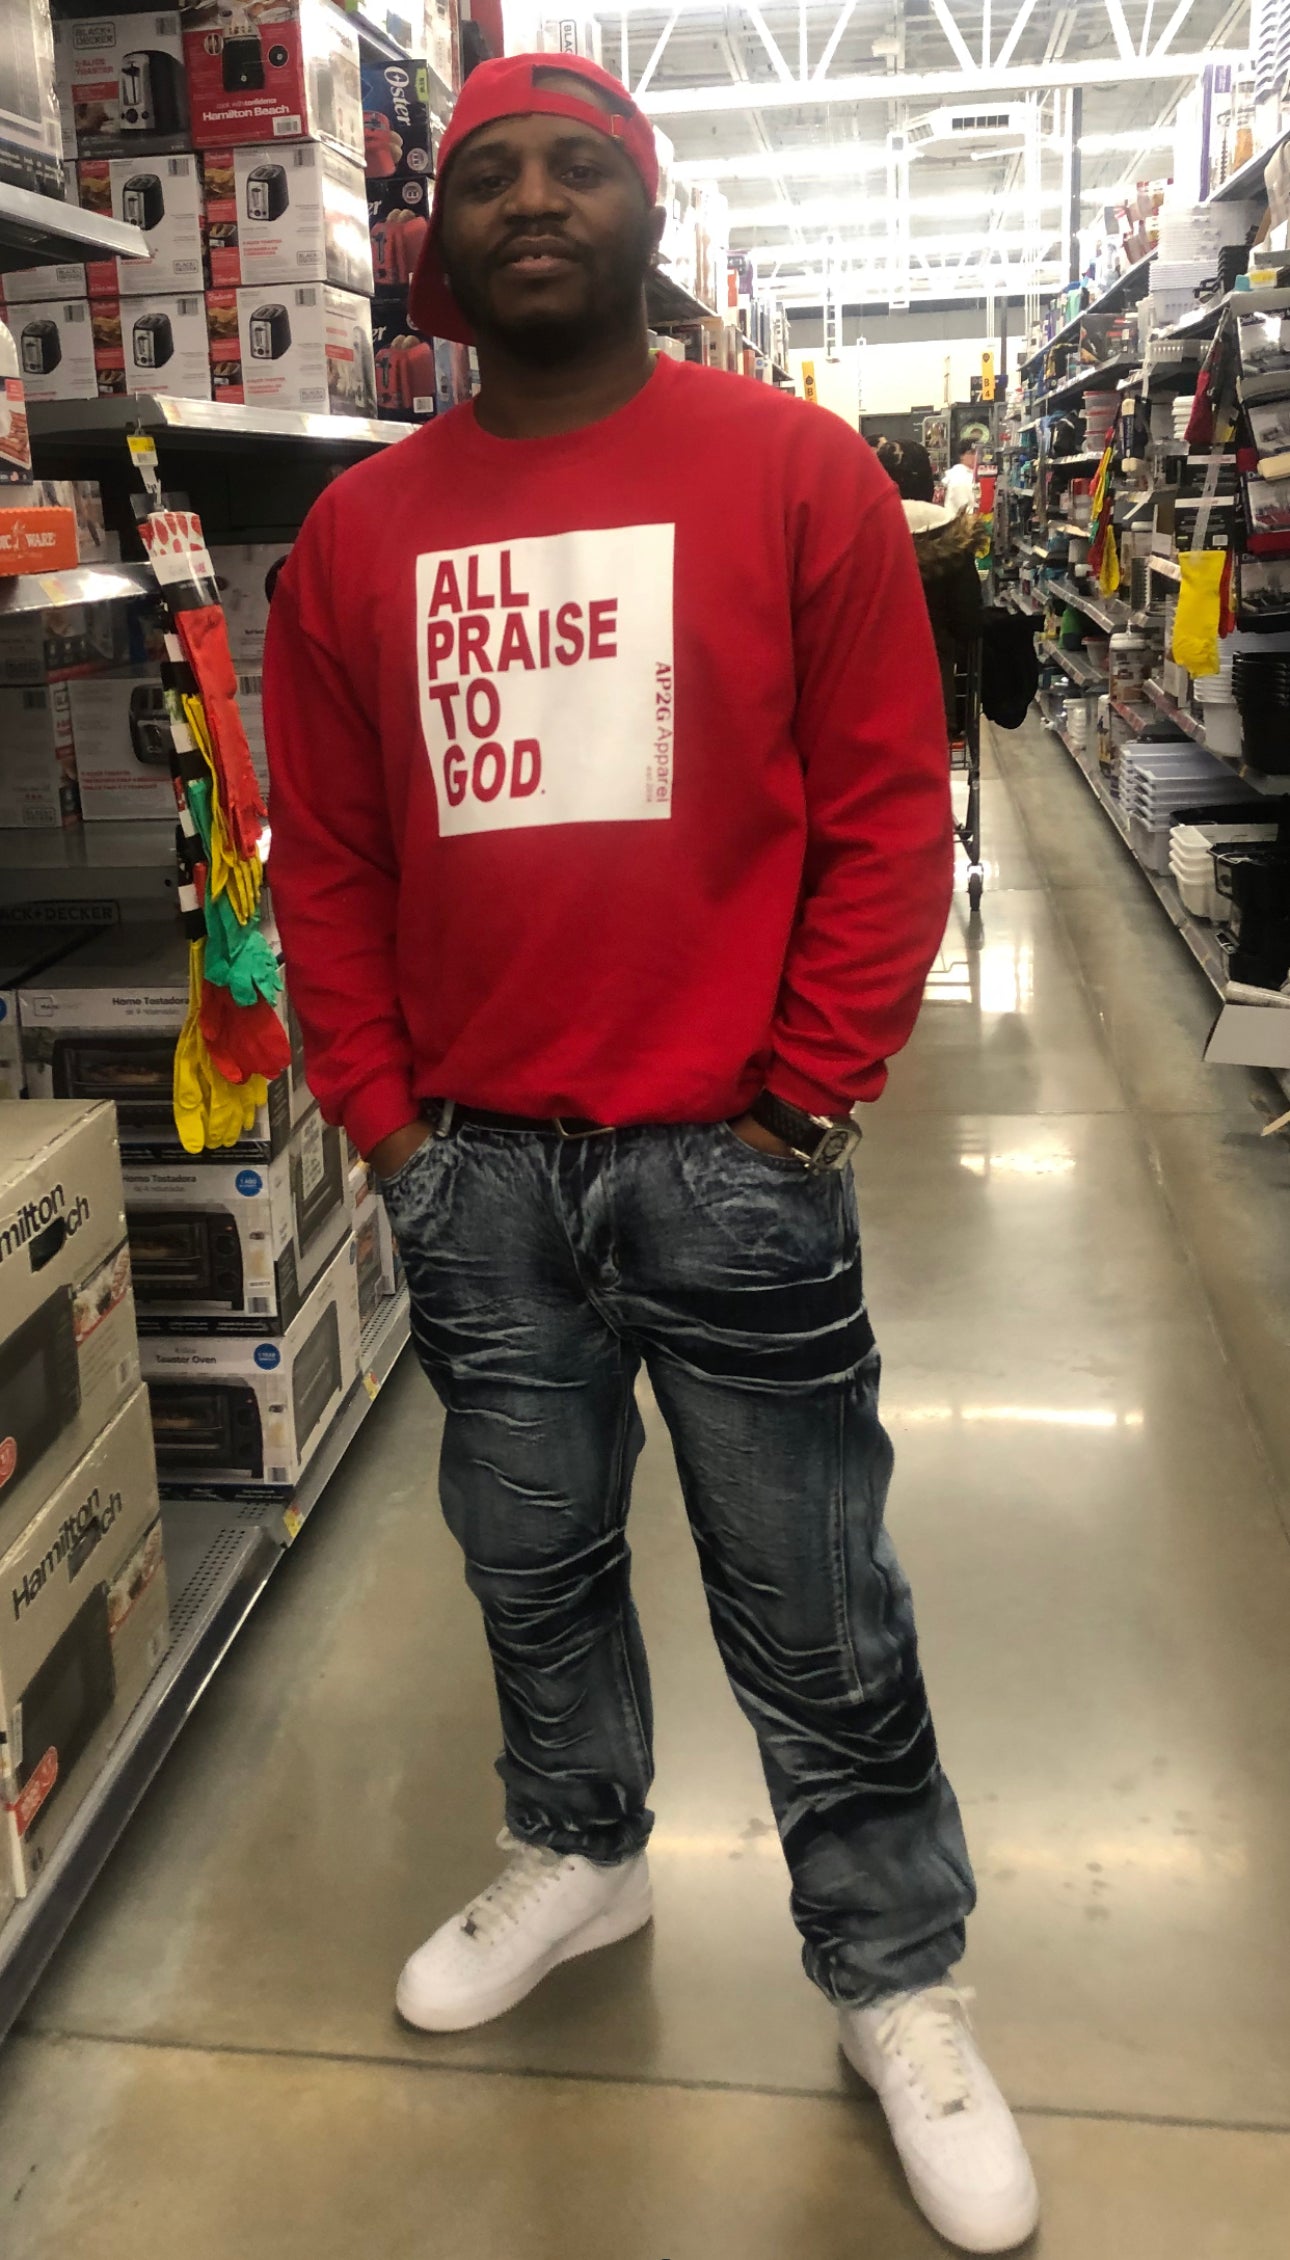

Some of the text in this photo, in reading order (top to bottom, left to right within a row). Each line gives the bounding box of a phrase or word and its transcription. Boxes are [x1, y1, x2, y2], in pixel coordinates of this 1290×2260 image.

[202, 105, 290, 121] Hamilton Beach
[383, 65, 412, 126] Oster
[428, 550, 529, 618] ALL
[427, 597, 618, 681] PRAISE
[428, 677, 501, 740] TO
[653, 661, 672, 803] AP2G Apparel
[443, 738, 546, 807] GOD.
[156, 1354, 217, 1364] Toaster Oven
[12, 1487, 100, 1621] Hamilton
